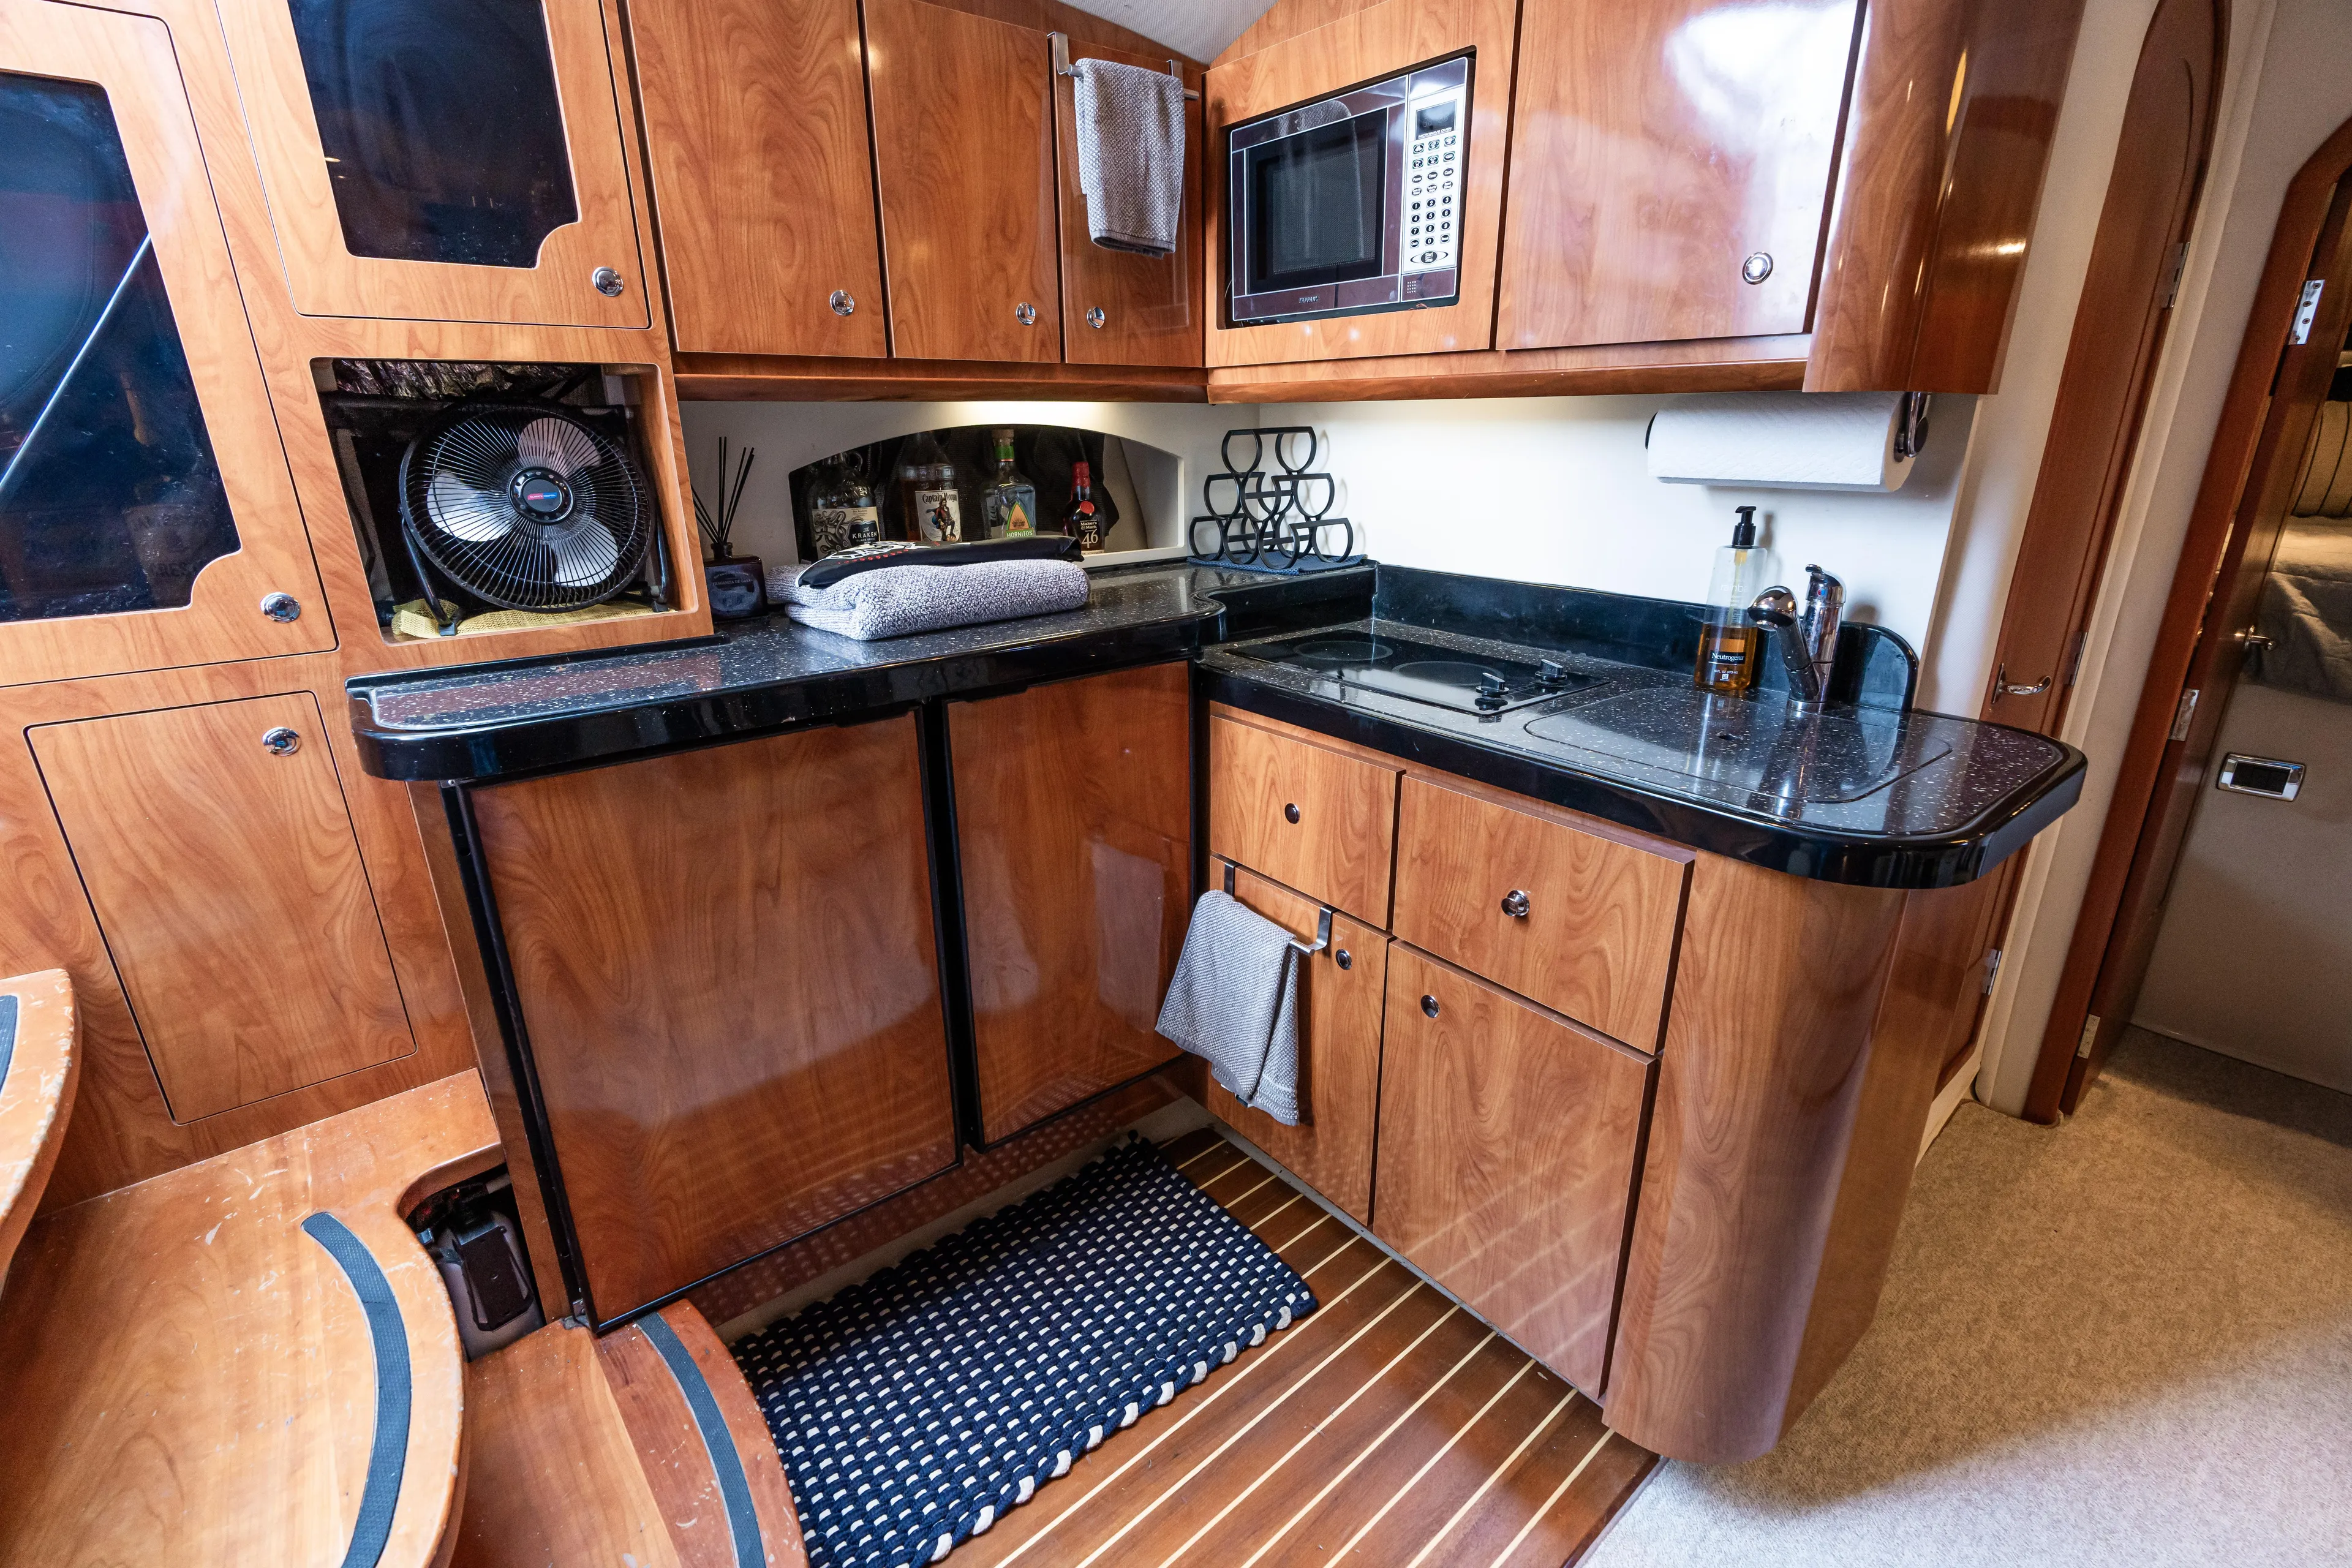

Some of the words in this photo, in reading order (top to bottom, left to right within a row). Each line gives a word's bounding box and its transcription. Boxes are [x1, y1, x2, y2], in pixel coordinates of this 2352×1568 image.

[1418, 130, 1440, 138] MICROWAVE
[922, 493, 942, 504] Captain
[1082, 529, 1098, 549] 46
[1711, 652, 1744, 662] Neutrogena
